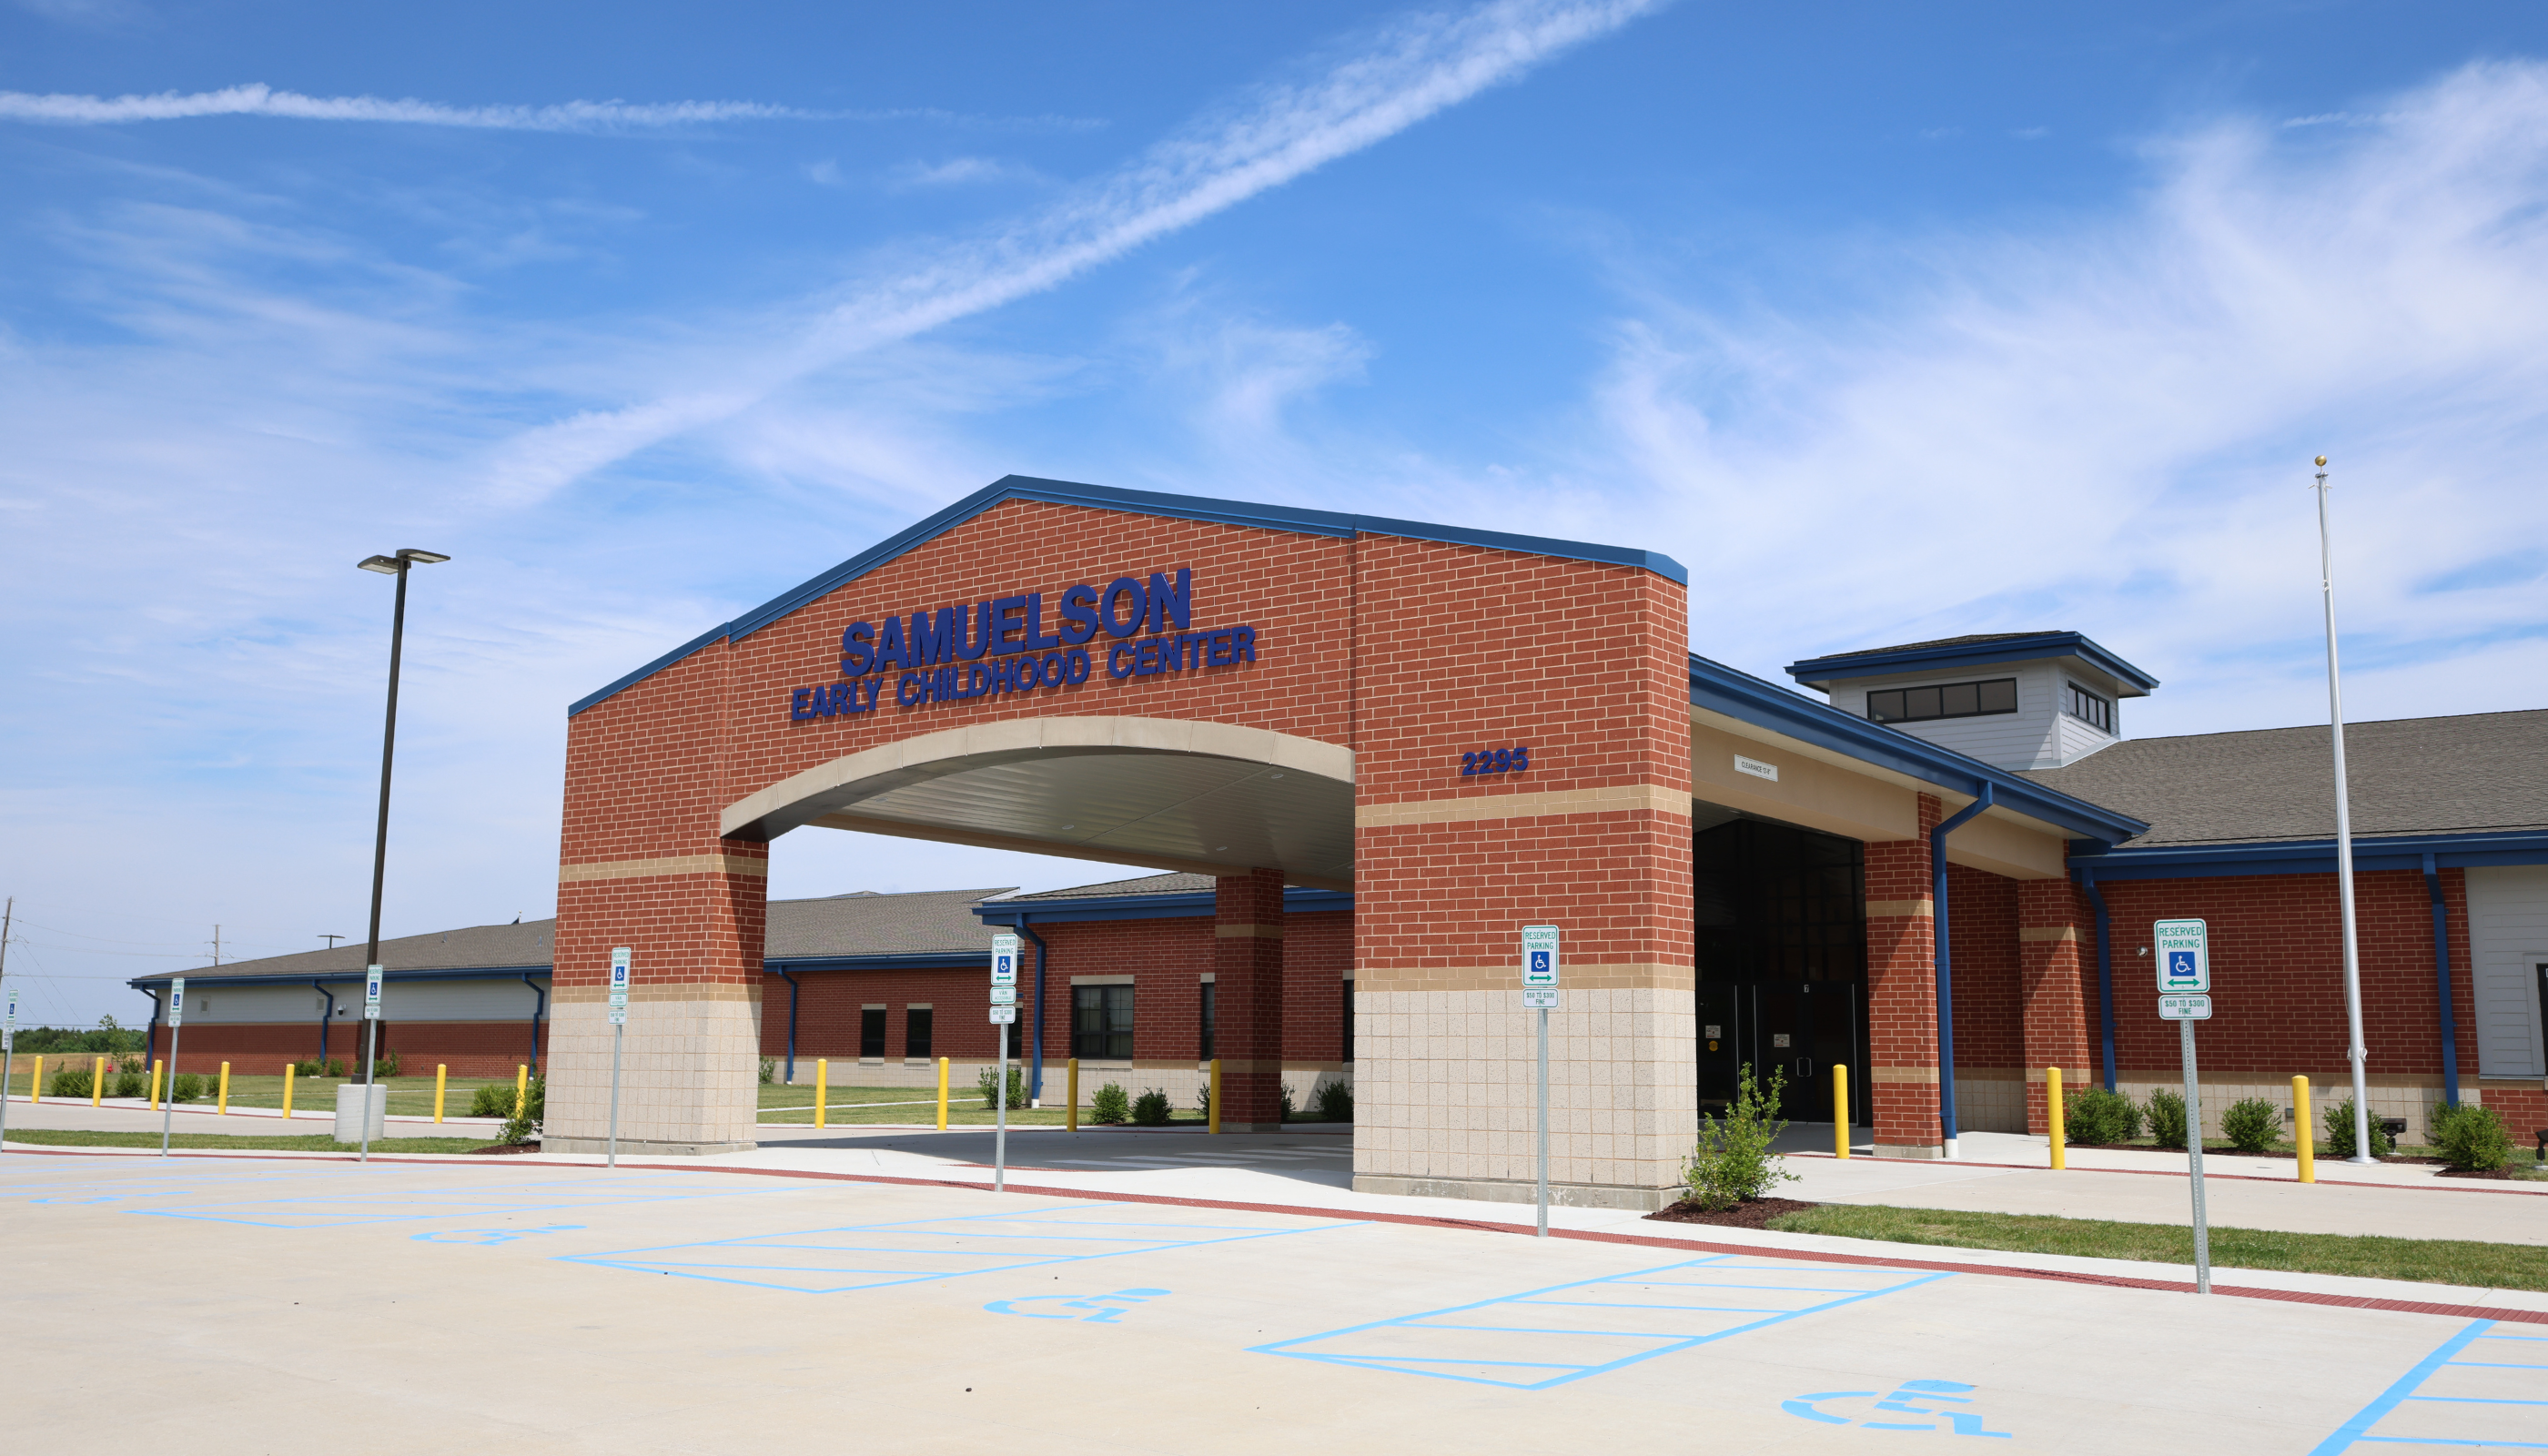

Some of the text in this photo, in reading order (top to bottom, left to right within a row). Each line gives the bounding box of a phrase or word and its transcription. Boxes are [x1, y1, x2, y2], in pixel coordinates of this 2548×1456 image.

[841, 568, 1191, 677] SAMUELSON
[792, 625, 1257, 721] EARLY CHILDHOOD CENTER
[1461, 747, 1529, 775] 2295
[1741, 761, 1763, 774] CLEARANCE
[1524, 931, 1556, 940] RESERVED
[2159, 926, 2202, 936] RESERVED
[1526, 942, 1554, 950] PARKING
[2162, 939, 2200, 948] PARKING
[2165, 999, 2205, 1007] $50 TO $300
